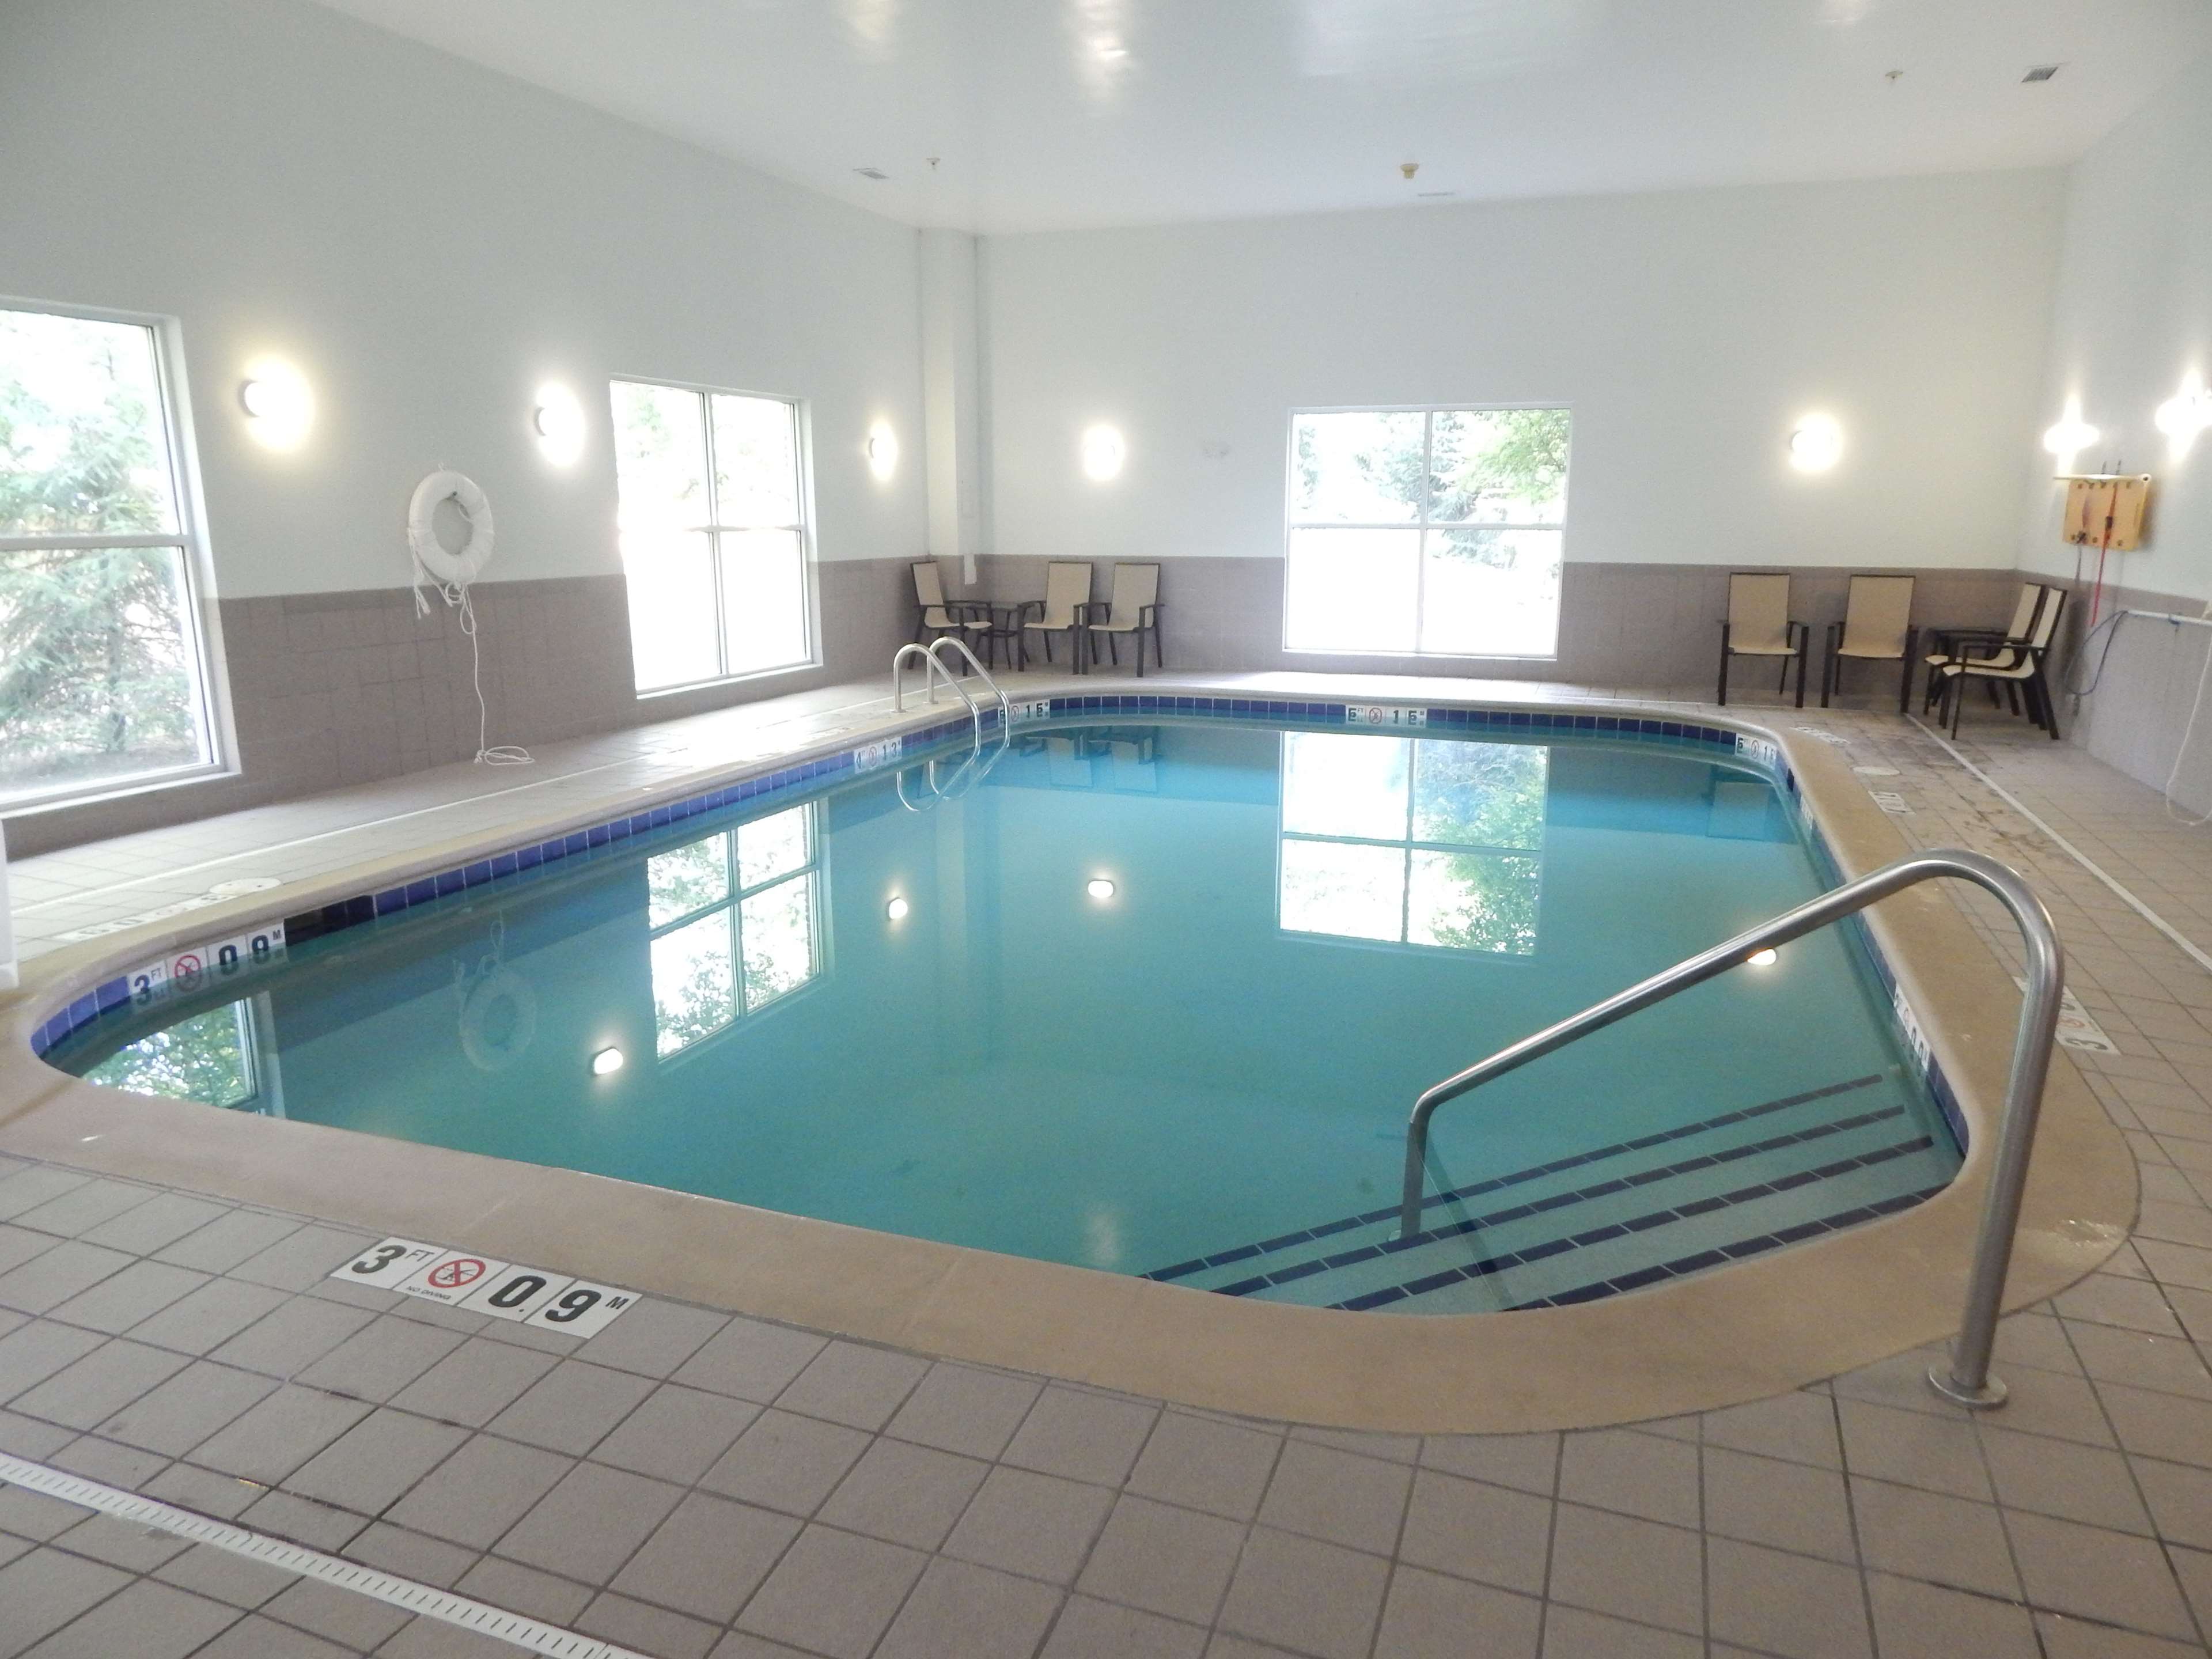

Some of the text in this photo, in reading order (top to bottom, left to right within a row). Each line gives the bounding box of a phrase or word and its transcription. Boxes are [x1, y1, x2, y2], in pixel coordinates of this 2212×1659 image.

[272, 929, 281, 941] M
[351, 1245, 407, 1274] 3
[404, 1249, 435, 1262] FT
[605, 1296, 630, 1309] M
